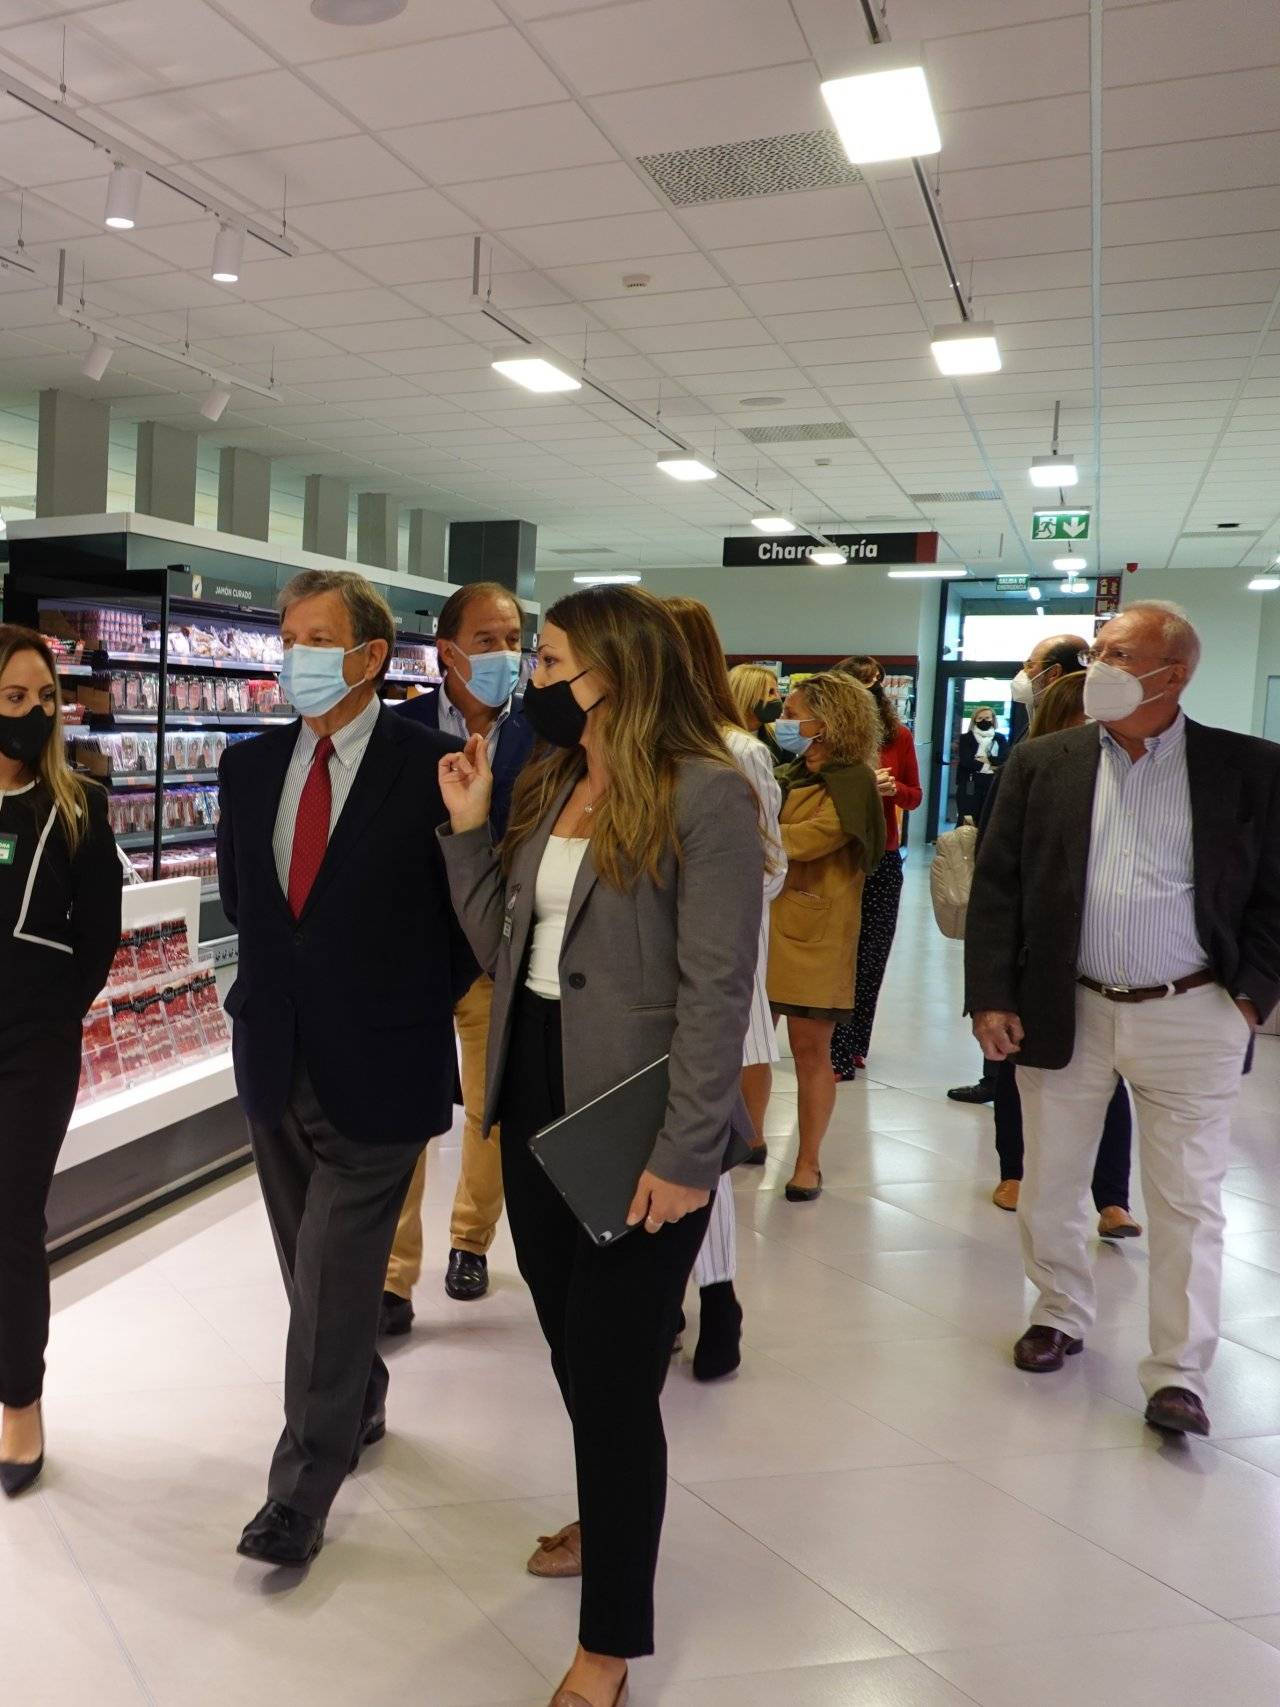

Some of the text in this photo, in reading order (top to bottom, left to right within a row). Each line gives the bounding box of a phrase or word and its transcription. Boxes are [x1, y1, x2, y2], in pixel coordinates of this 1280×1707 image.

[758, 539, 878, 560] Charcería
[215, 585, 252, 600] JAMÓN CURADO
